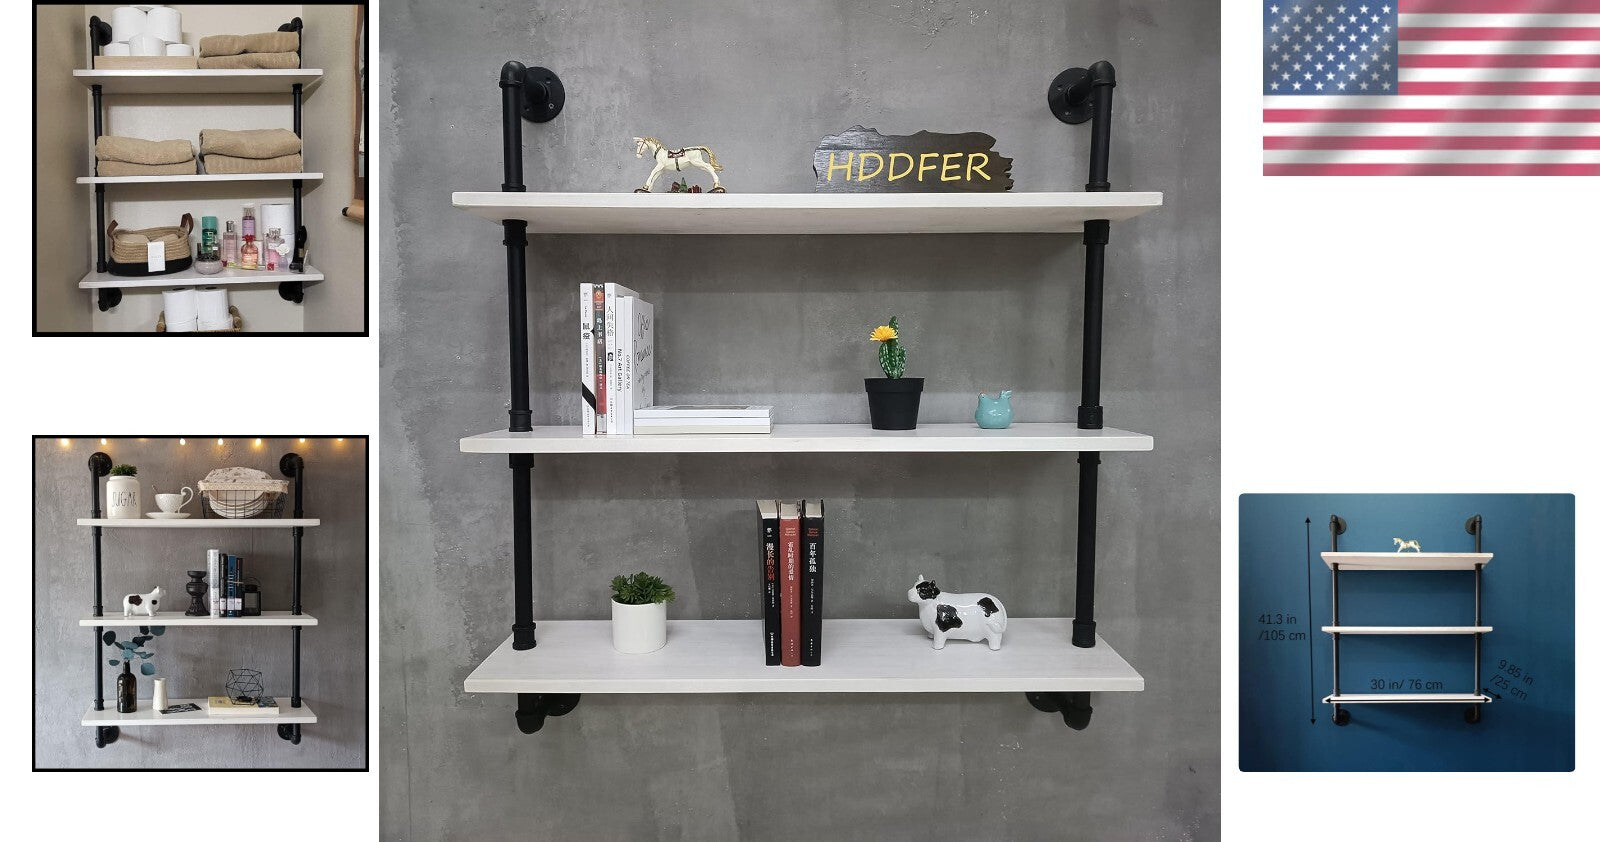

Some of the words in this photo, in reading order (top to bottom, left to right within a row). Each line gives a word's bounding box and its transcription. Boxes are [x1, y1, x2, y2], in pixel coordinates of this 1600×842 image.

[826, 151, 992, 182] HDDFER
[766, 542, 775, 581] 漫长的告别
[809, 542, 817, 573] 百年孤独
